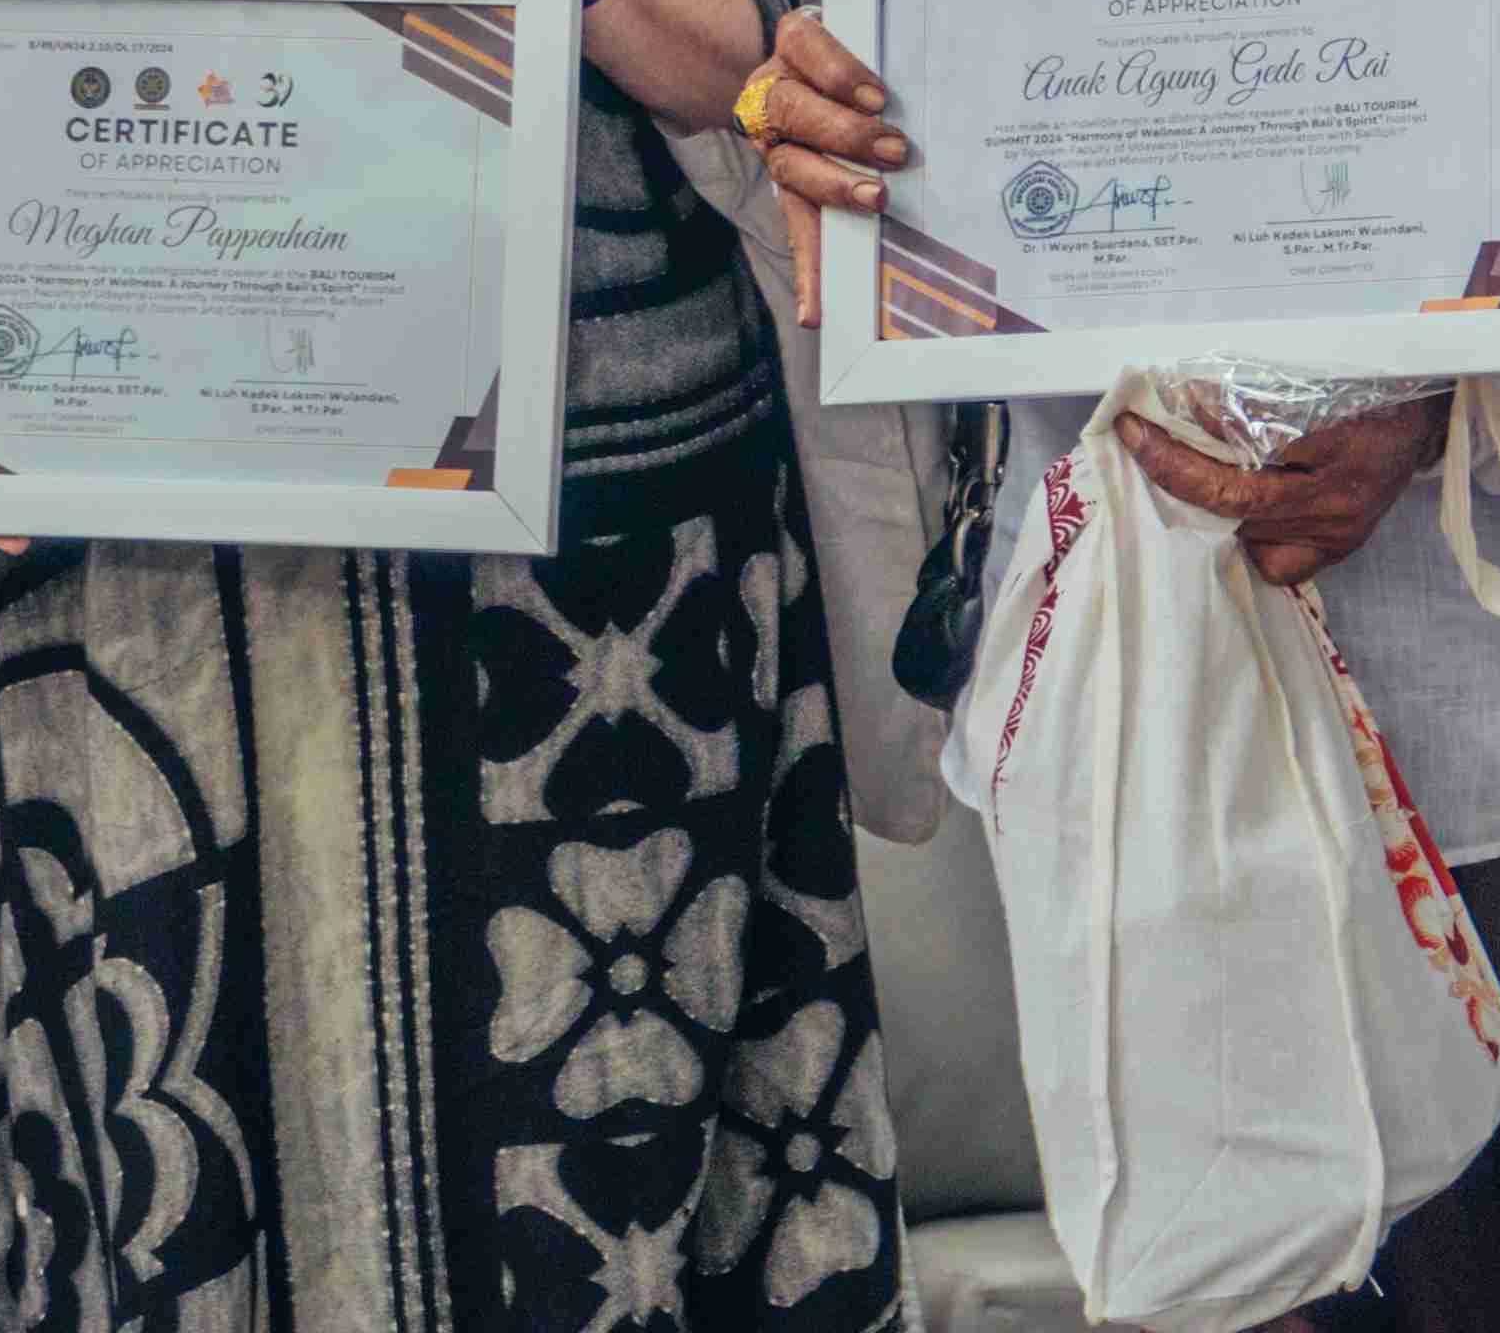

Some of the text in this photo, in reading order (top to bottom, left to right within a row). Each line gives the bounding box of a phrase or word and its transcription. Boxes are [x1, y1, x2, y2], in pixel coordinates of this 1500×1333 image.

[1021, 35, 1392, 109] Anak Agung Gede Rai
[1332, 102, 1361, 113] BALI
[1363, 98, 1418, 111] TOURISM
[64, 113, 299, 150] CERTIFICATE
[1035, 132, 1065, 143] 2024
[79, 150, 281, 176] OF APPRECIATION
[6, 197, 349, 265] Meghan Pappenheim
